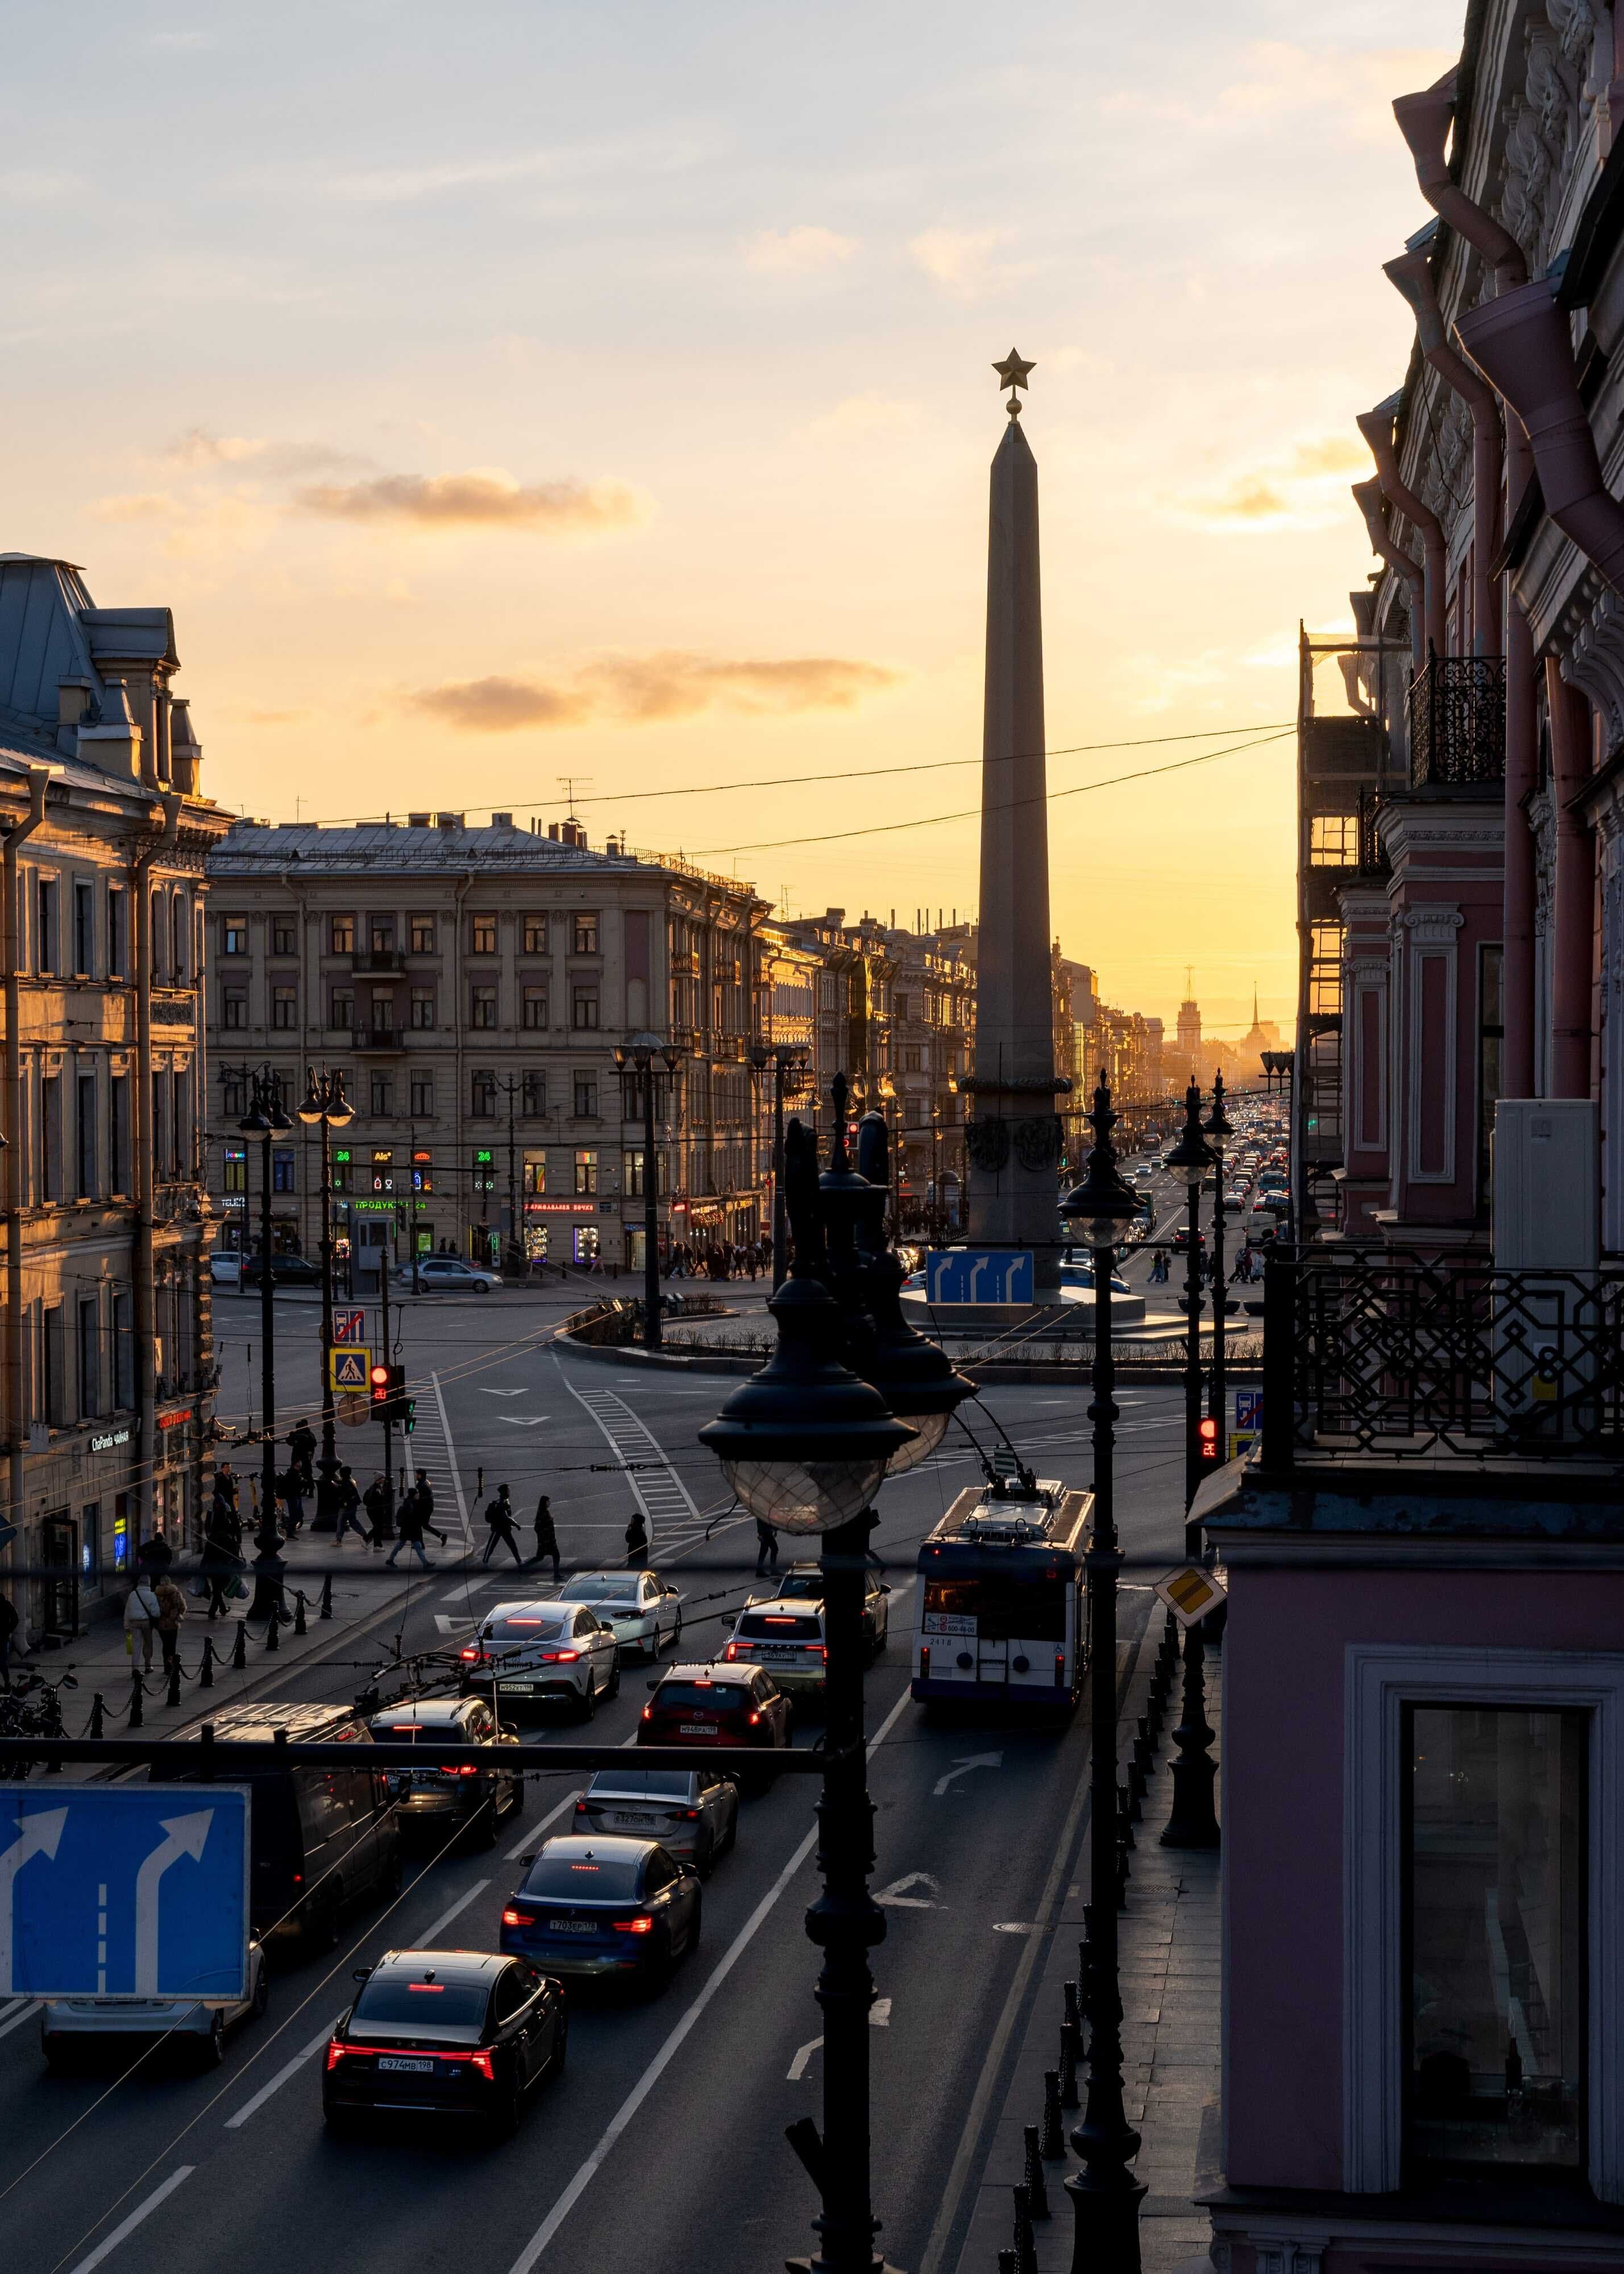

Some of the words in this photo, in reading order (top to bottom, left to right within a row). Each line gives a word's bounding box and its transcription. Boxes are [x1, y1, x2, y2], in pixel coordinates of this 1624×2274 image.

[337, 1151, 350, 1161] 24
[478, 1151, 491, 1161] 24
[375, 1388, 386, 1399] 28
[92, 1434, 113, 1451] ChaPanda
[114, 1431, 129, 1445] ЧАЙНАЯ
[552, 1921, 582, 1930] Т703ЕР
[381, 2060, 416, 2070] С974МВ
